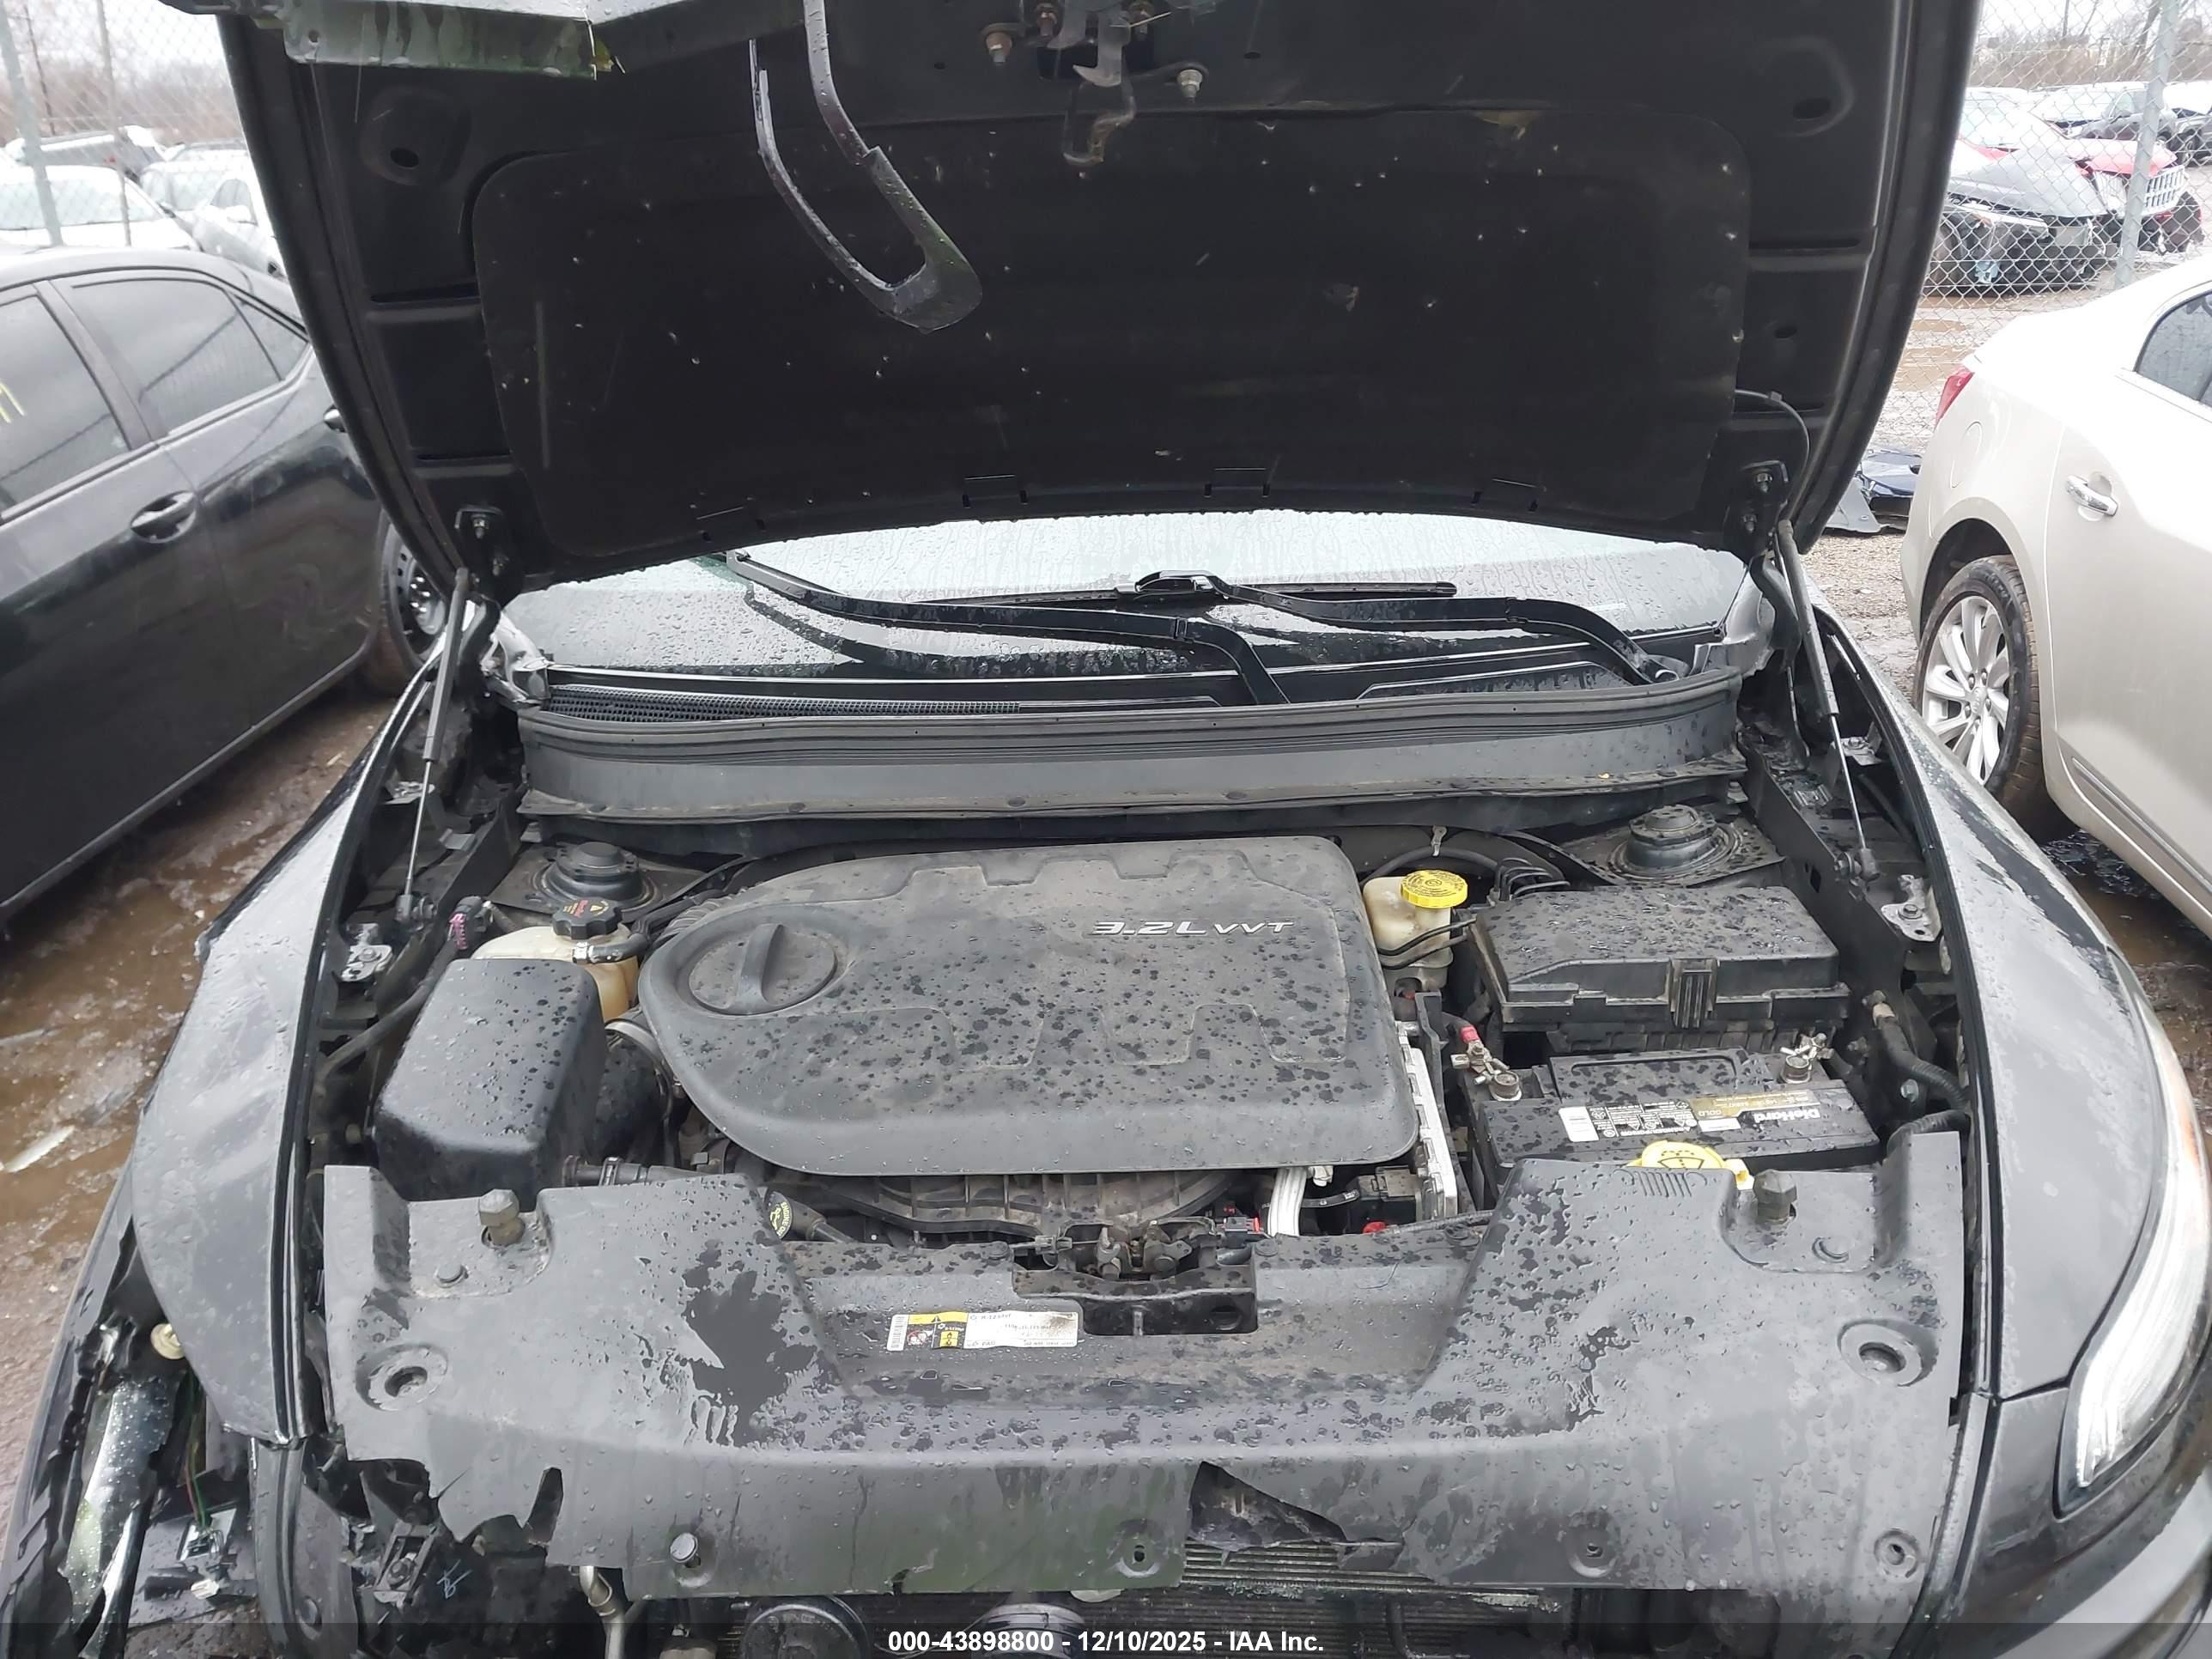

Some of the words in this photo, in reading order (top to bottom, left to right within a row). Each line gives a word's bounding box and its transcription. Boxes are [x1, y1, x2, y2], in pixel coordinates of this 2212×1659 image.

[1088, 921, 1207, 935] 3.2L
[1212, 921, 1294, 935] VVT
[1753, 1108, 1821, 1124] DieHard
[781, 1201, 790, 1226] ENGINE
